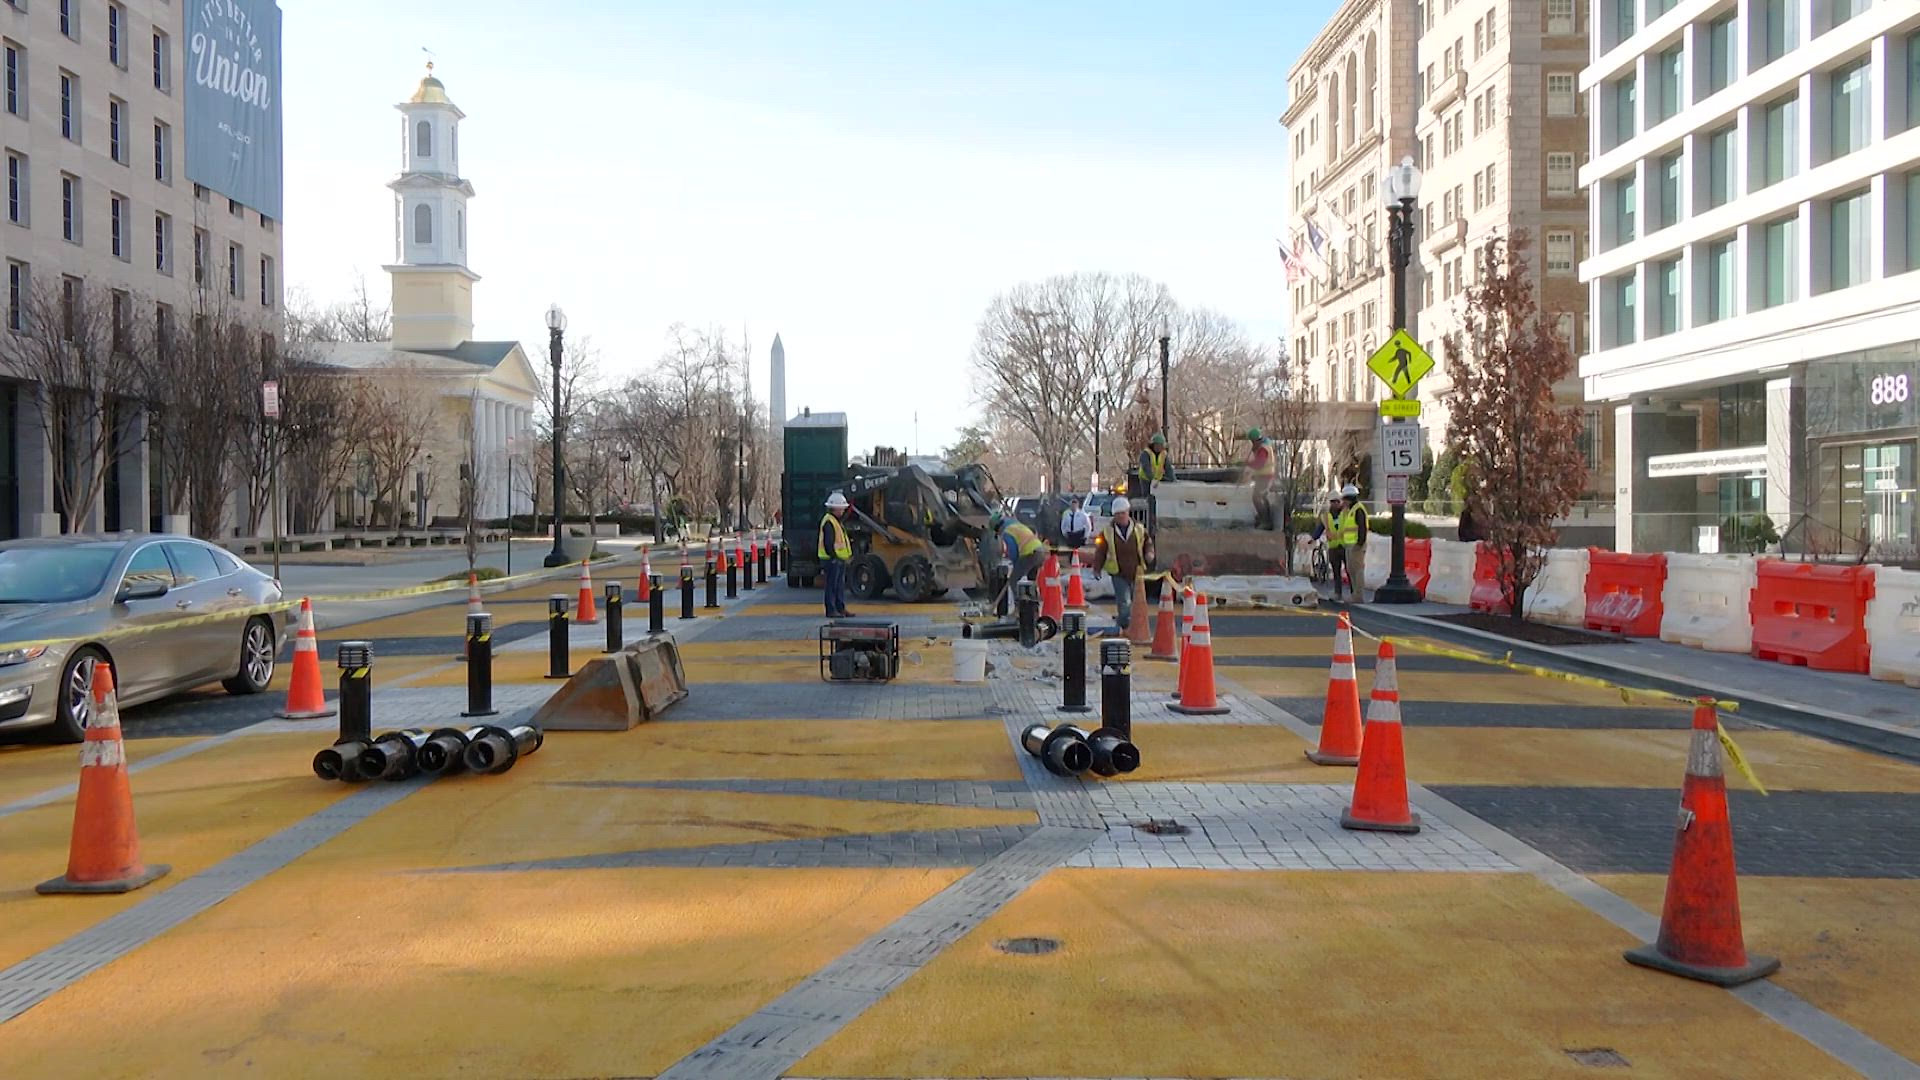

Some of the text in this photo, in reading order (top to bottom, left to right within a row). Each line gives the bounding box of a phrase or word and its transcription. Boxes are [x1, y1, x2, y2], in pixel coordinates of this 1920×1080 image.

[201, 0, 263, 64] IT'S BETTER
[191, 32, 271, 111] Union
[1871, 374, 1908, 405] 888
[1386, 428, 1416, 438] SPEED
[1388, 439, 1413, 447] LIMIT
[1390, 449, 1413, 467] 15
